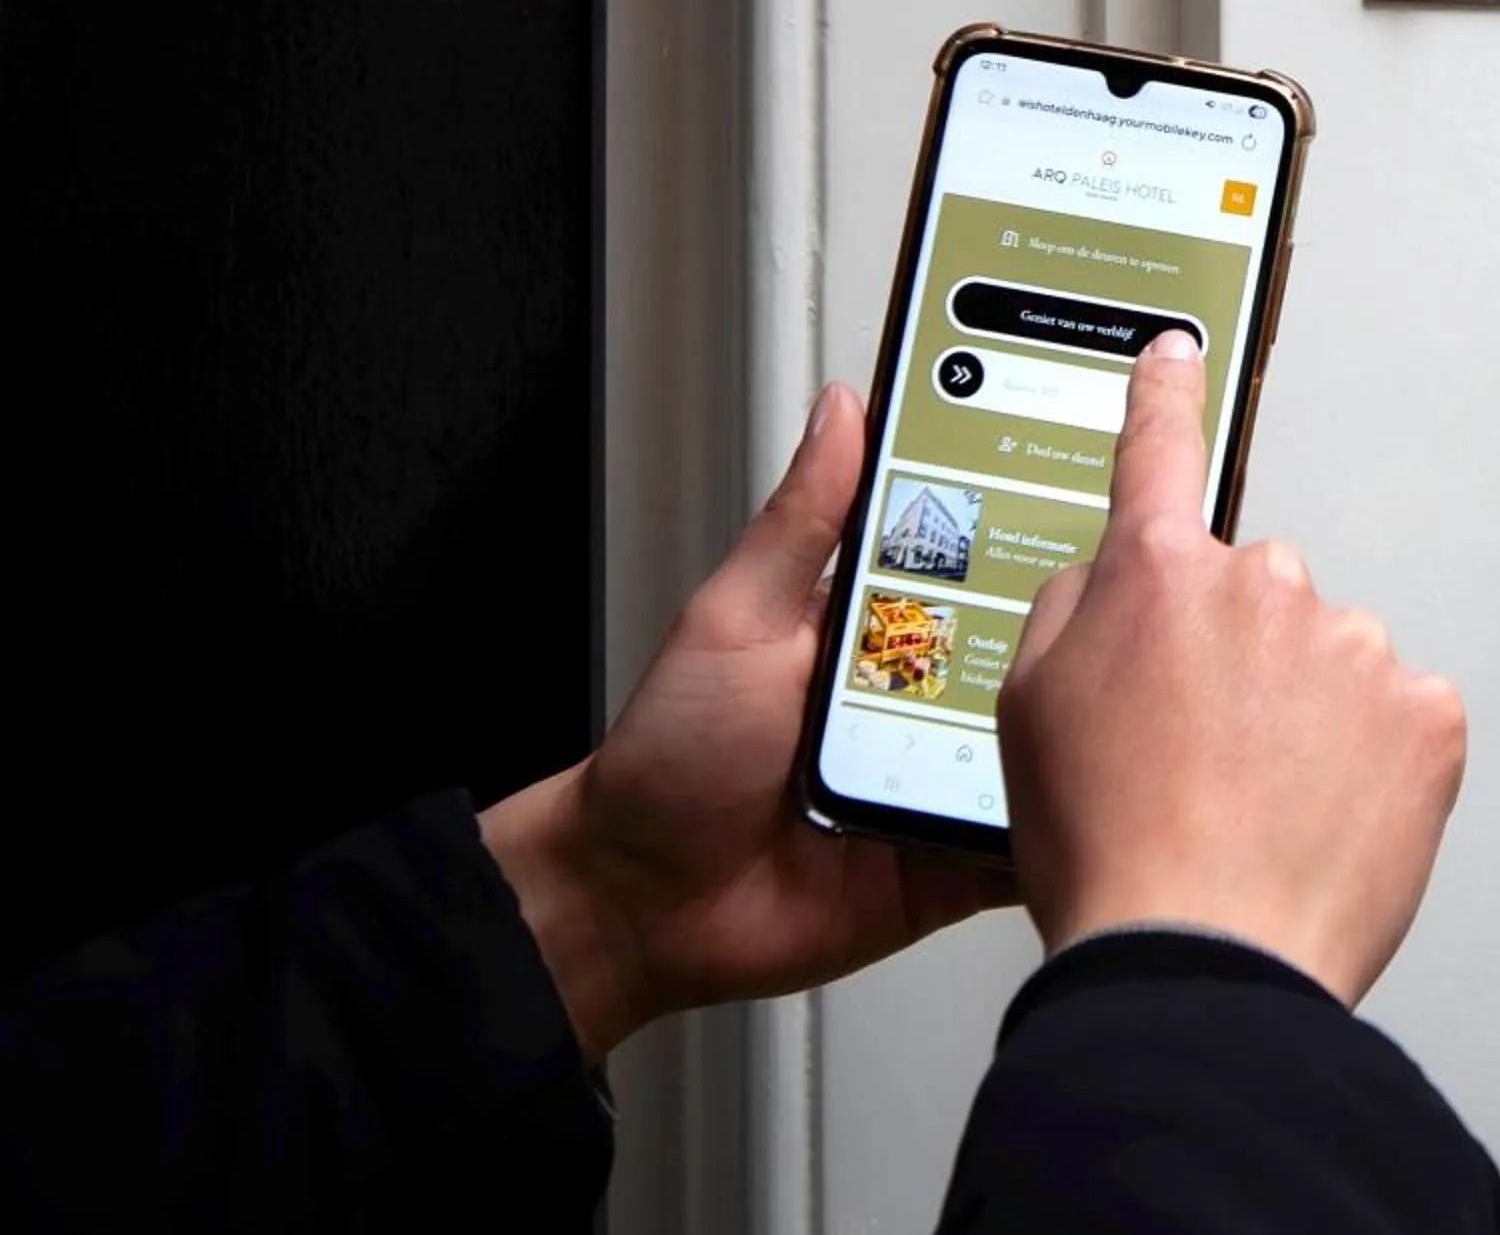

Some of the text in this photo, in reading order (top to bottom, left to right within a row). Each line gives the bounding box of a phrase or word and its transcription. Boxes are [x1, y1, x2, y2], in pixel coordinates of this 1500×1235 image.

[1031, 167, 1068, 185] ARQ
[1071, 172, 1122, 195] PALEIS
[1125, 182, 1176, 205] HOTEL
[1020, 310, 1056, 326] Geniet
[1057, 317, 1076, 331] van
